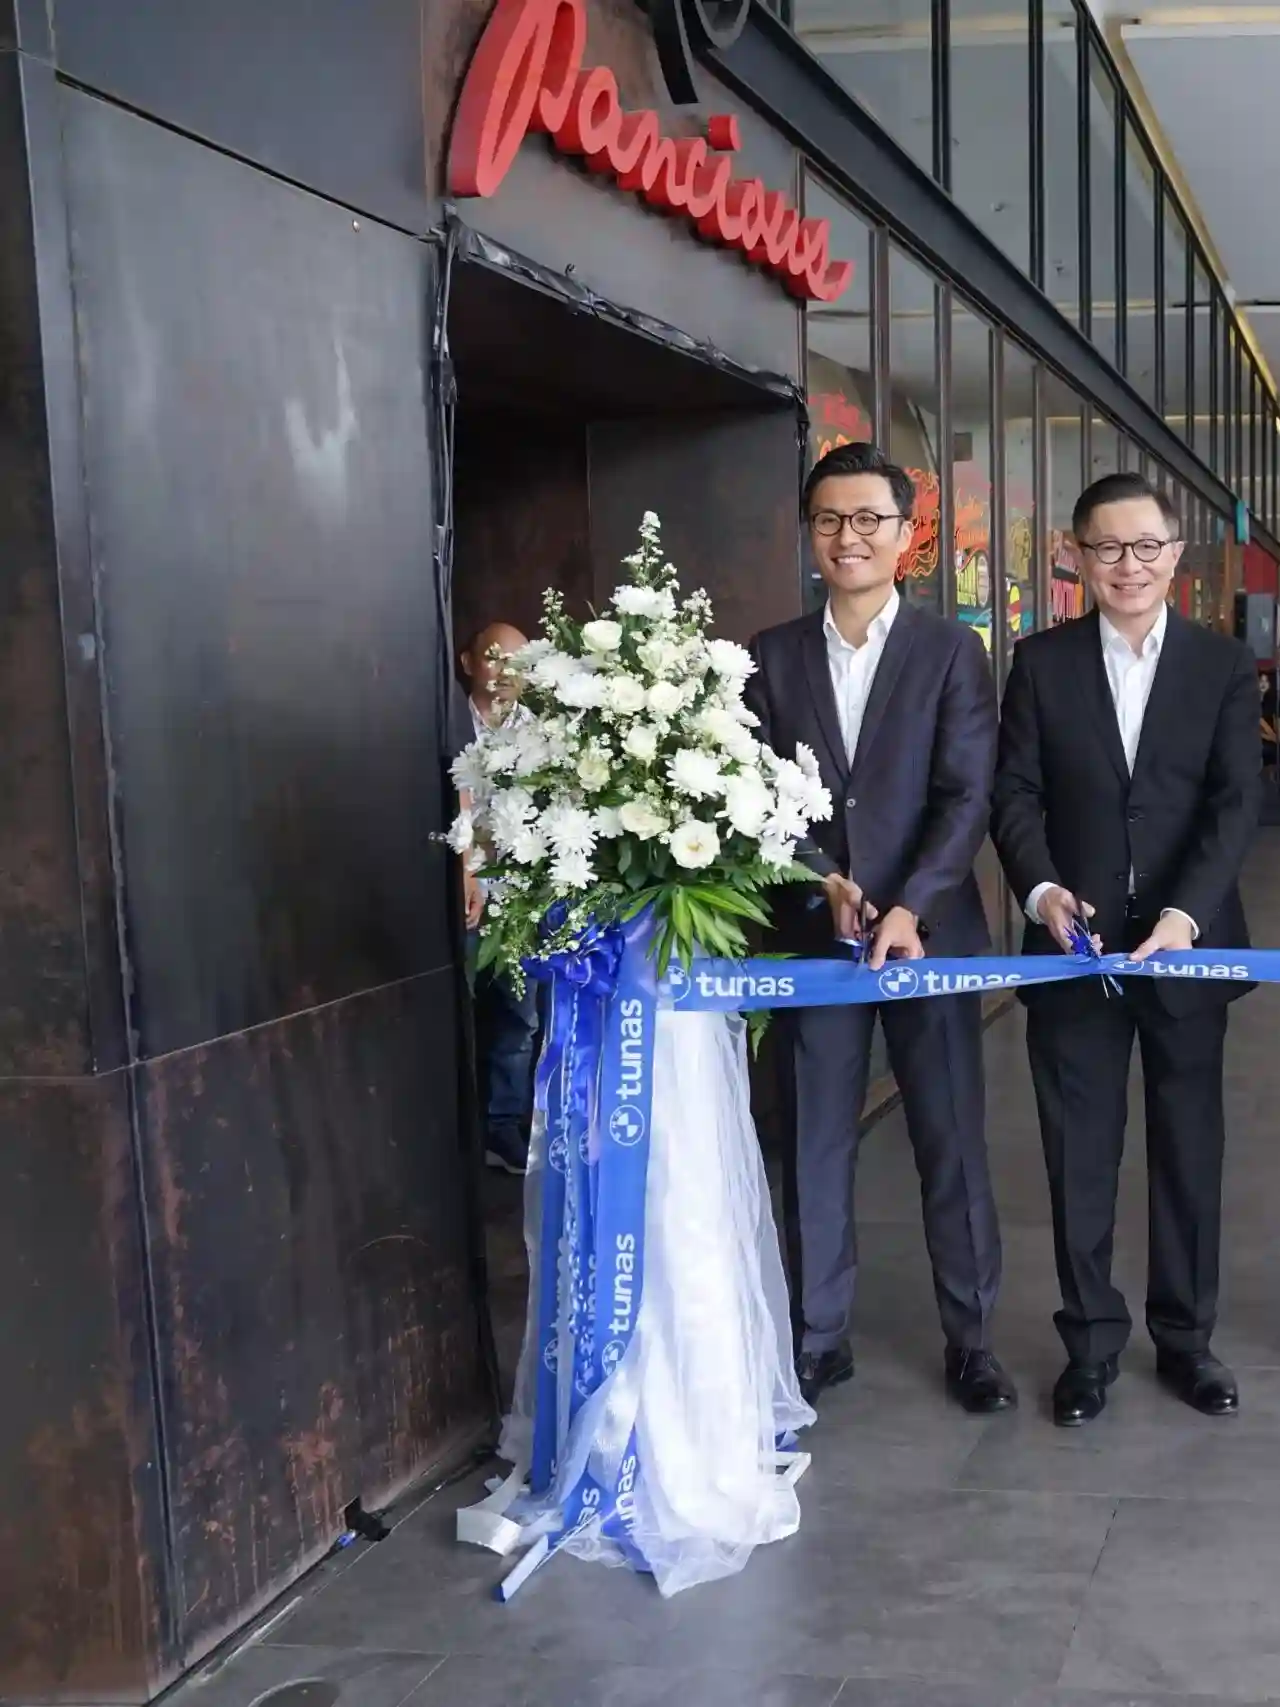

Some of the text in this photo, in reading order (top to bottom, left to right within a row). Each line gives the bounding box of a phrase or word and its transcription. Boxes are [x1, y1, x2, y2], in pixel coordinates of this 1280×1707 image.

[449, 0, 854, 301] Pancious
[696, 972, 795, 997] tunas
[1149, 961, 1249, 978] tunas
[616, 999, 643, 1100] tunas
[608, 1233, 635, 1335] tunas
